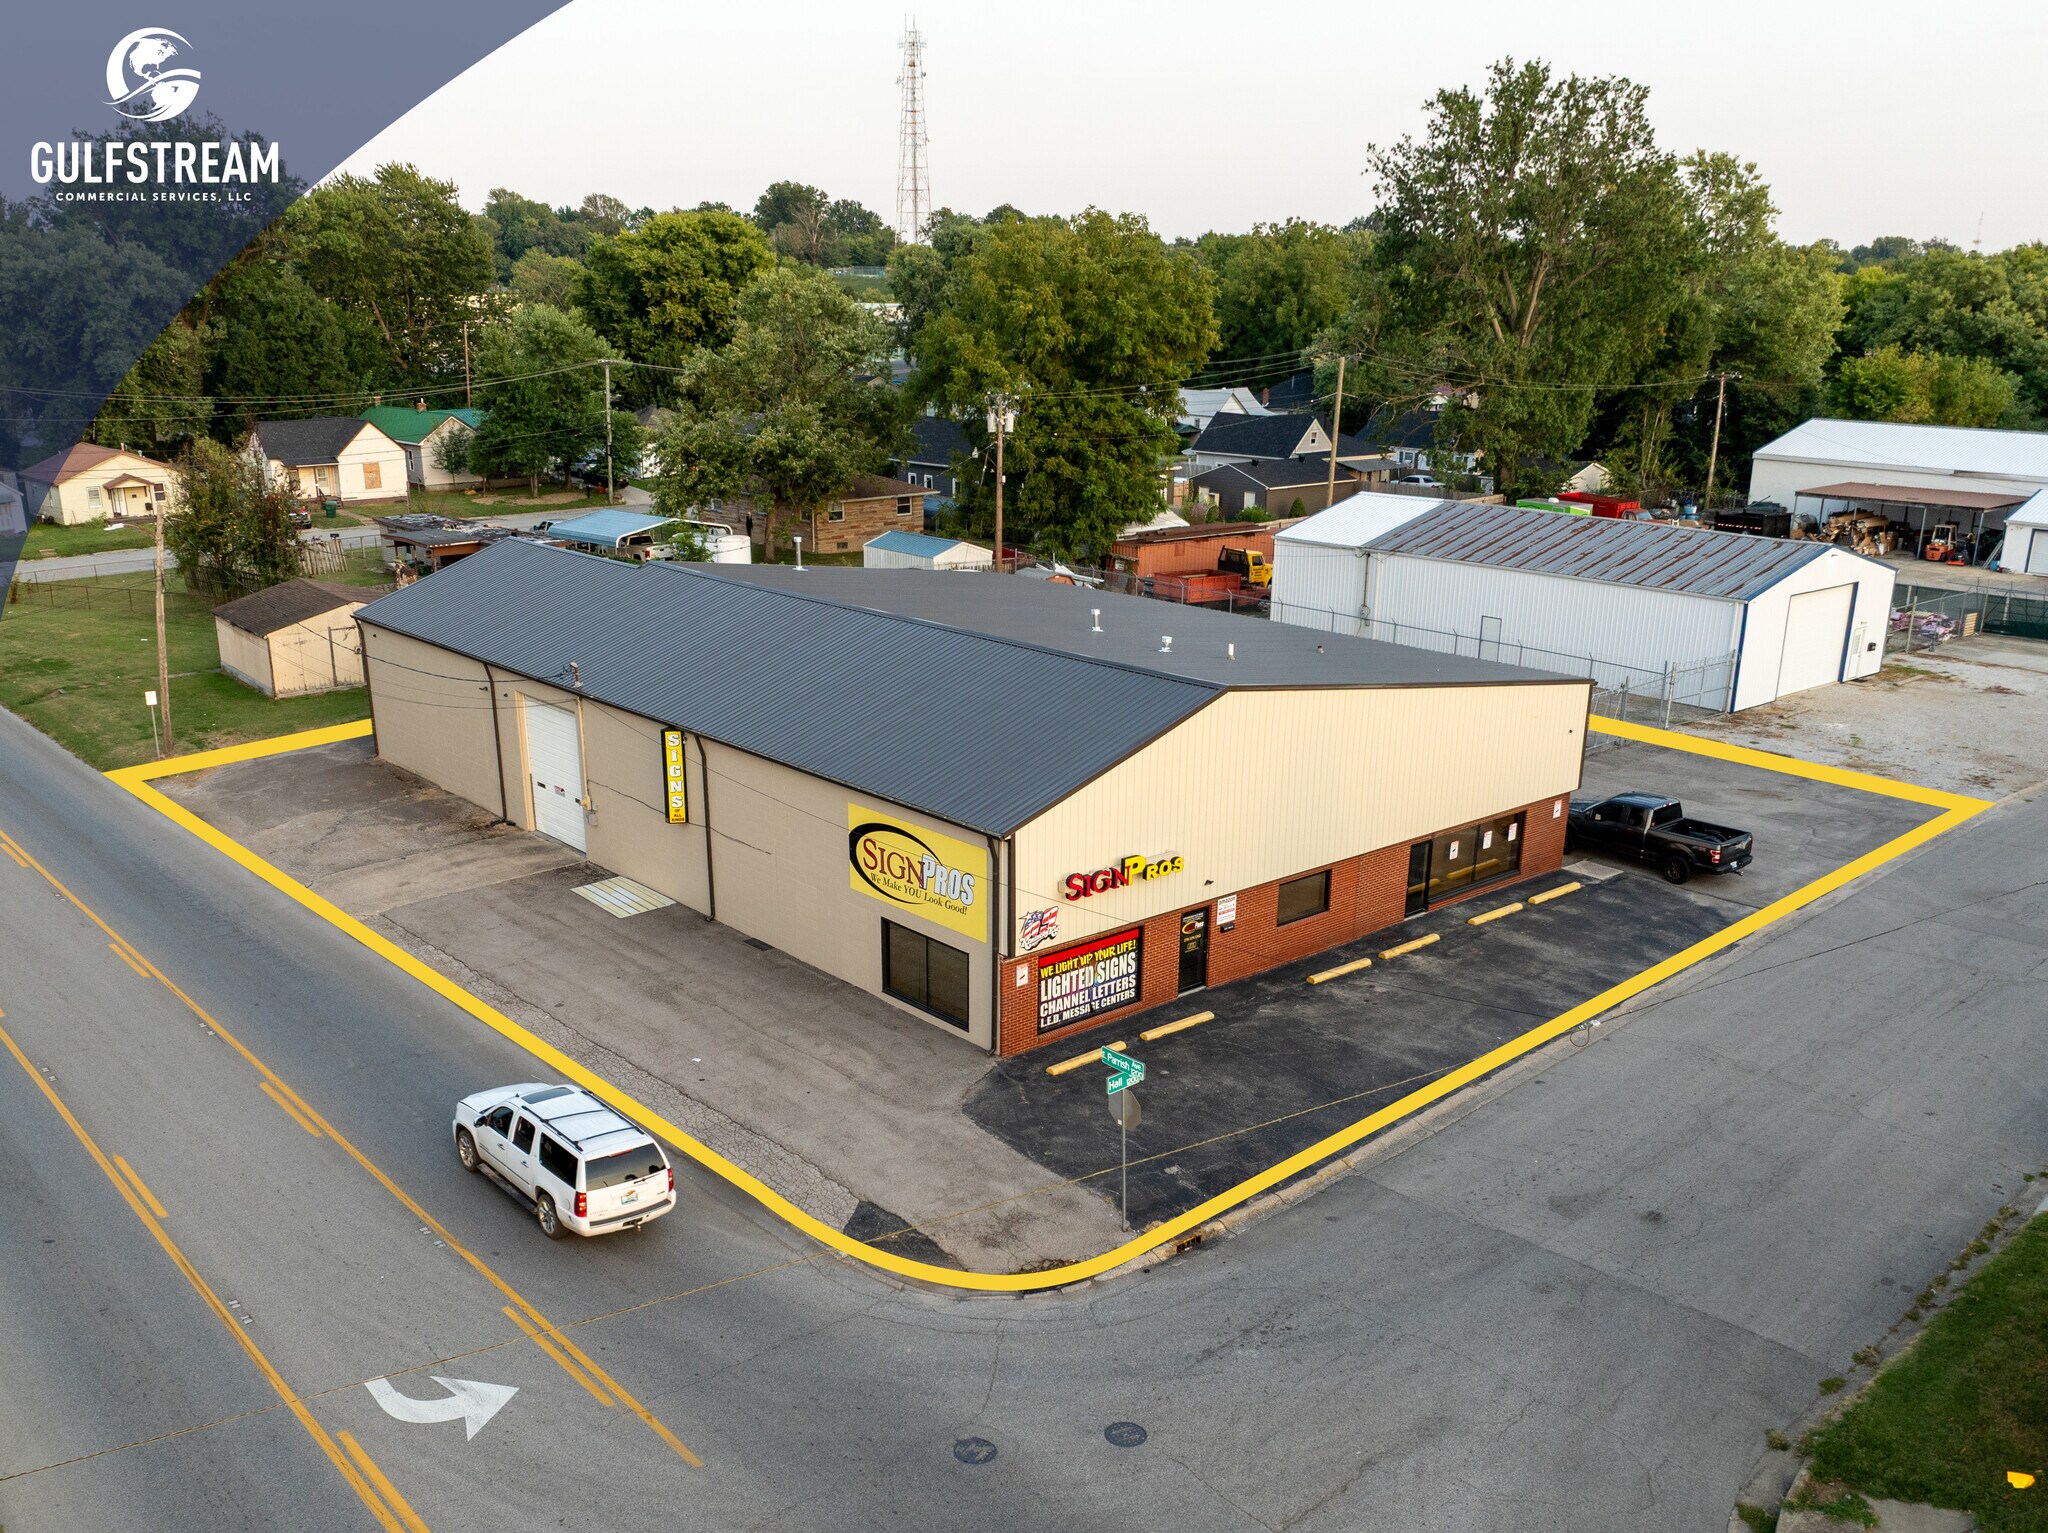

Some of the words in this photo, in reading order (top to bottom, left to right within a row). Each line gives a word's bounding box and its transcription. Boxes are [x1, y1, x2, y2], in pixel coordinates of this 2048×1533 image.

[667, 734, 683, 808] SIGNS
[870, 872, 881, 884] We
[883, 878, 902, 892] Make
[904, 885, 922, 899] YOU
[923, 892, 943, 907] Look
[944, 900, 968, 915] Good!
[1040, 965, 1054, 979] WE
[1055, 957, 1079, 974] LIGHT
[1080, 953, 1093, 966] UP
[1094, 946, 1116, 961] YOUR
[1117, 939, 1136, 954] LIFE!
[1040, 965, 1094, 1002] LIGHTED
[1097, 951, 1136, 984] SIGNS
[1040, 989, 1090, 1017] CHANNEL
[1092, 974, 1136, 1000] LETTERS
[1040, 1013, 1061, 1028] L.E.D.
[1101, 988, 1136, 1008] CENTERS
[1107, 1052, 1130, 1071] Parrish
[1109, 1077, 1123, 1091] Hall
